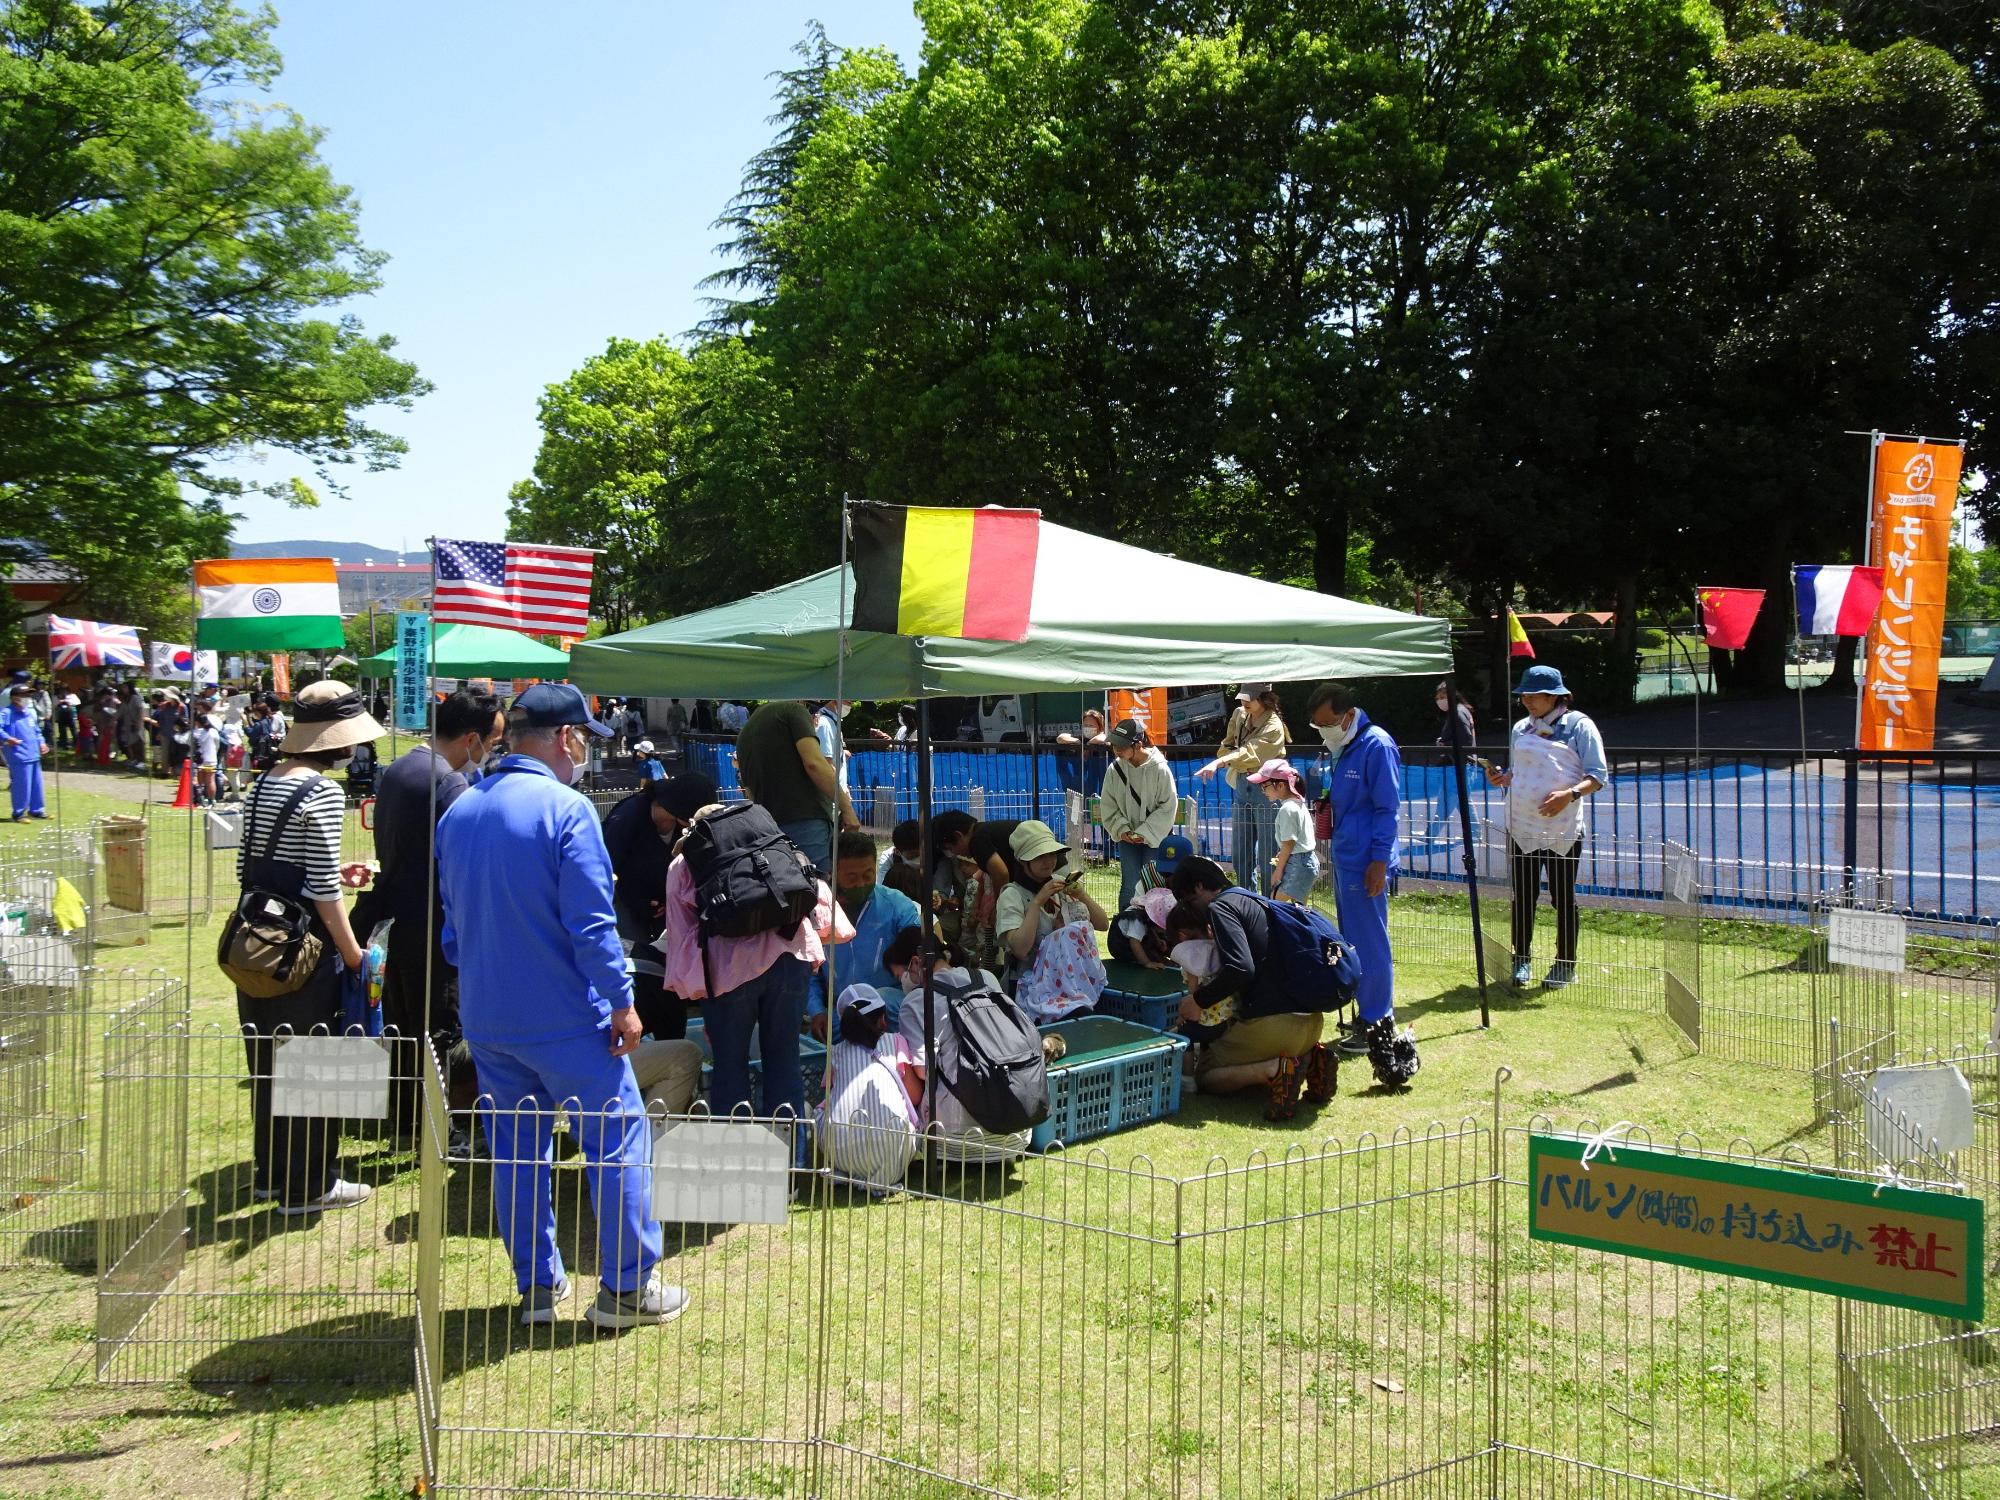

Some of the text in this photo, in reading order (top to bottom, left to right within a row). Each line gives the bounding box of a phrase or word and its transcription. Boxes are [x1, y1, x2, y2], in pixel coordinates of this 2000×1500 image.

[404, 628, 417, 714] 秦野市青少年指導員
